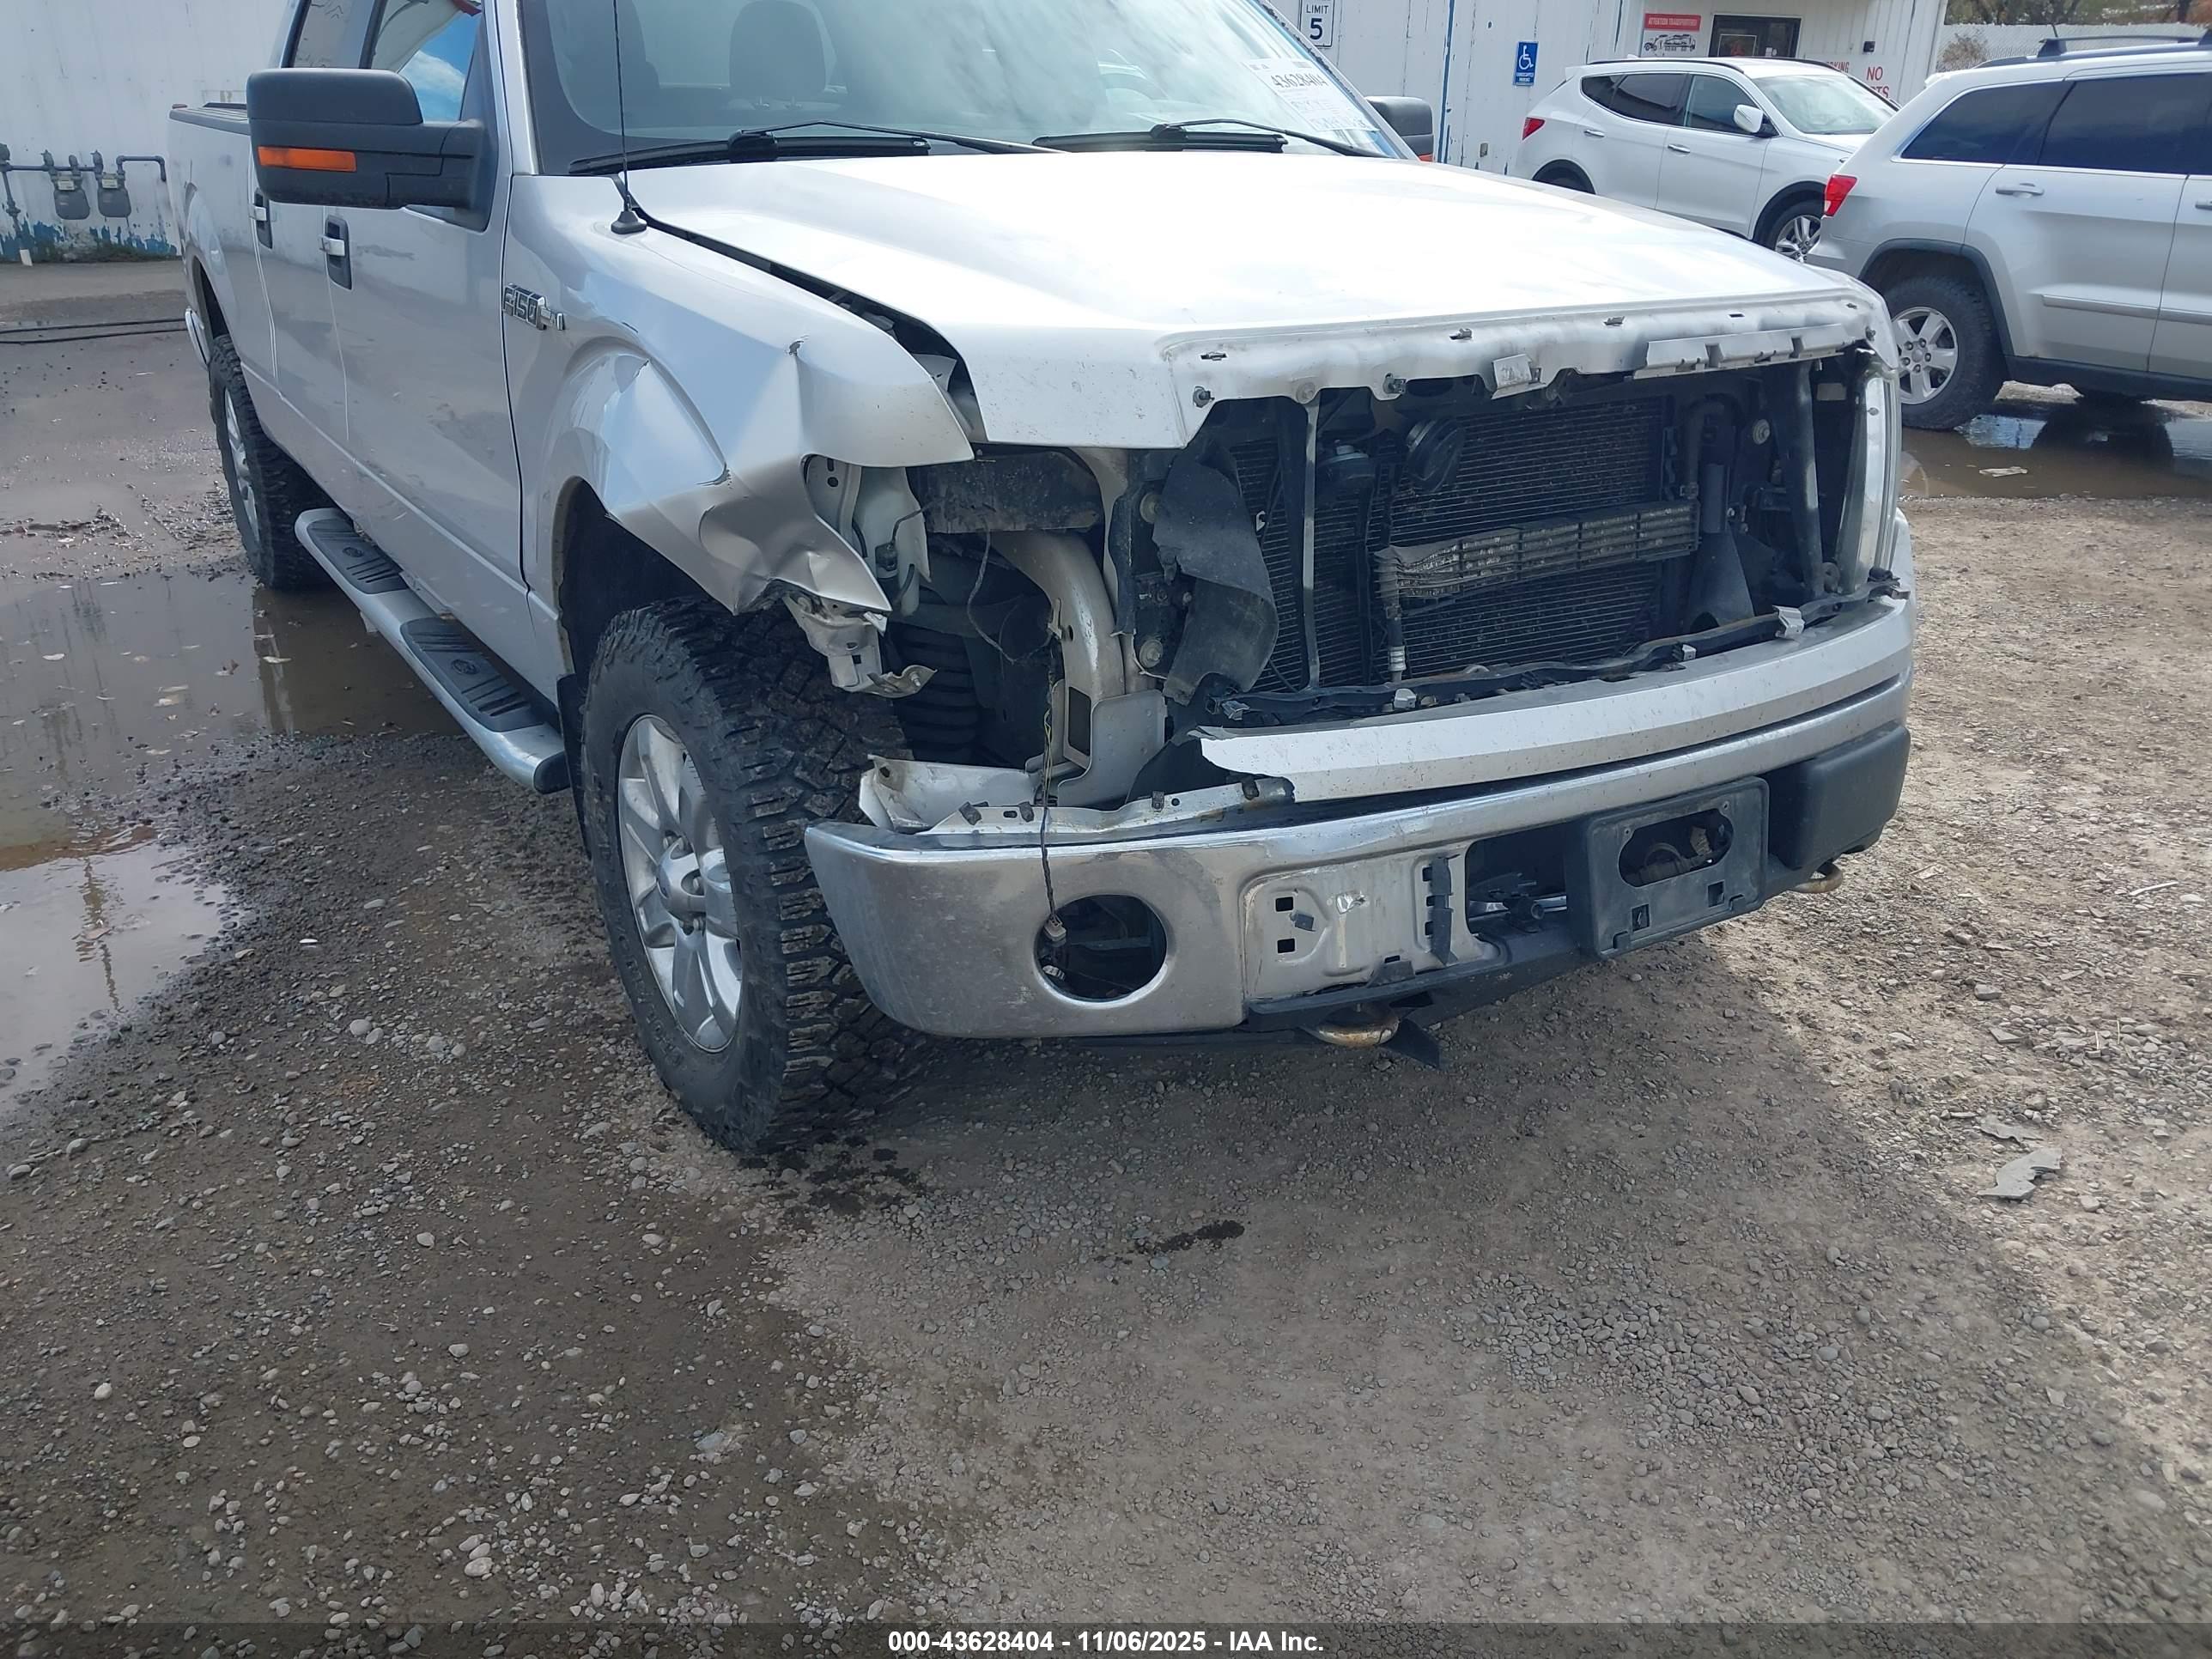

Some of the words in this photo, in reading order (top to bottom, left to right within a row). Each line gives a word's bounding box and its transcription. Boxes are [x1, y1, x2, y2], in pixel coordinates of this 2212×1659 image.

[1306, 4, 1328, 14] LIMIT
[1310, 17, 1322, 40] 5
[1866, 66, 1883, 81] NO
